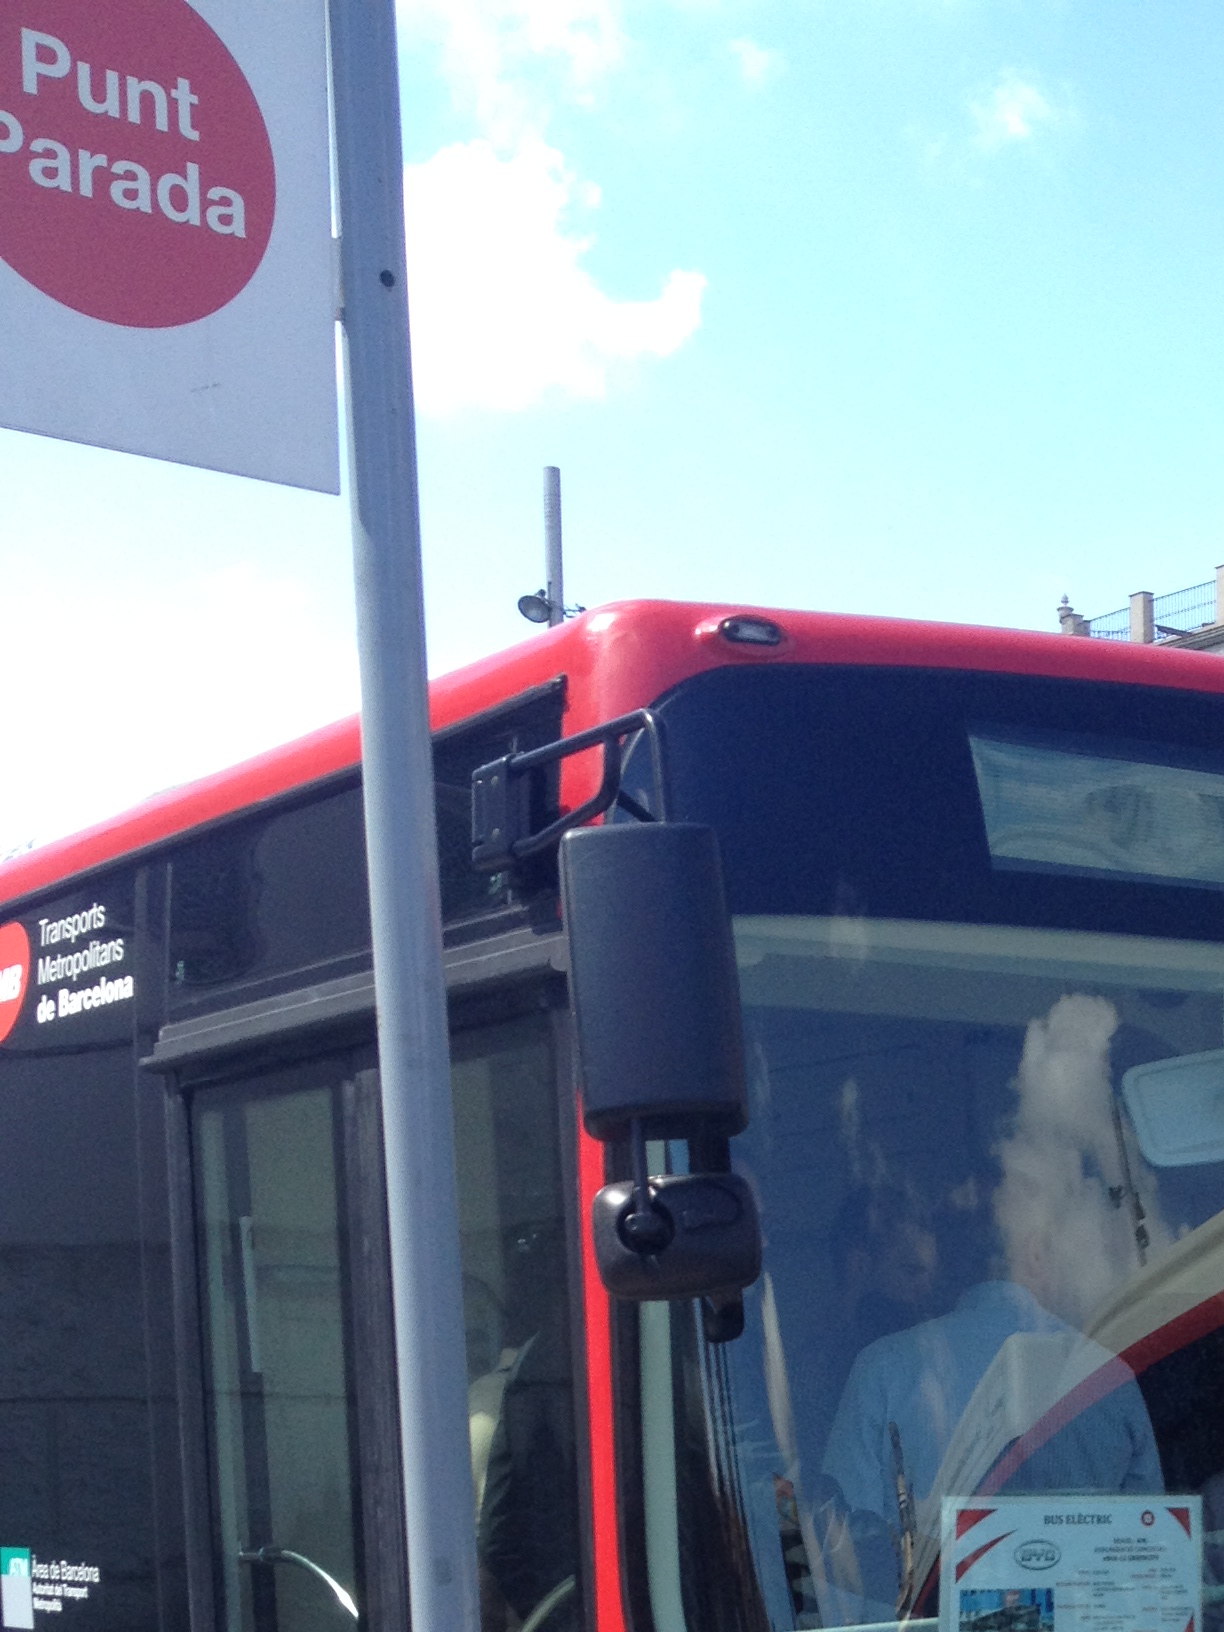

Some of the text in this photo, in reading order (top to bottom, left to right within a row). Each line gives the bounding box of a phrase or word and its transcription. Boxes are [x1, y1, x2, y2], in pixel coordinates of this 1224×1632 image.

[21, 27, 200, 141] Punt
[39, 903, 106, 946] Transports
[38, 938, 124, 985] Metropolitans
[37, 975, 134, 1023] de Barcelona
[1044, 1514, 1063, 1525] BUS
